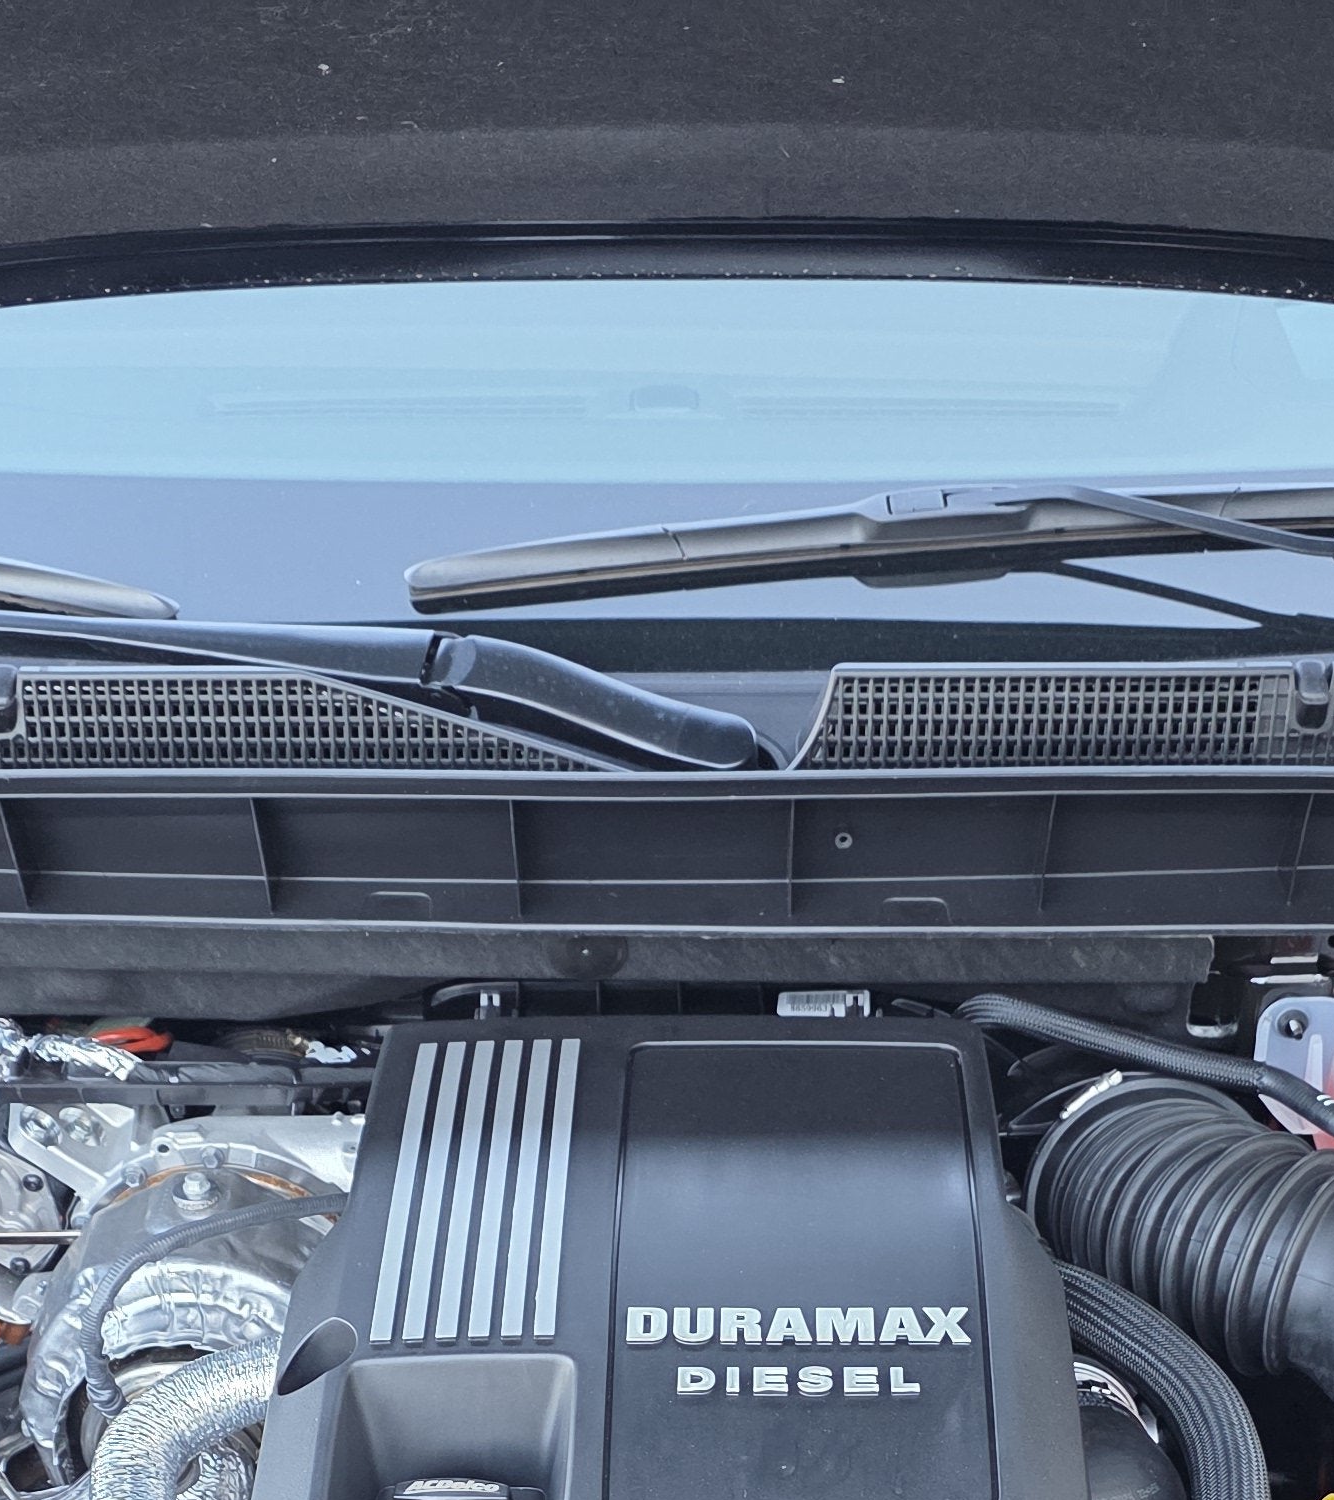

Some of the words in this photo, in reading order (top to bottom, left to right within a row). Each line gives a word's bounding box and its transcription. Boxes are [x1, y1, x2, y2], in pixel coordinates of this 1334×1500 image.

[625, 1306, 972, 1345] DURAMAX
[676, 1365, 921, 1397] DIESEL
[403, 1480, 500, 1494] ACDelco
